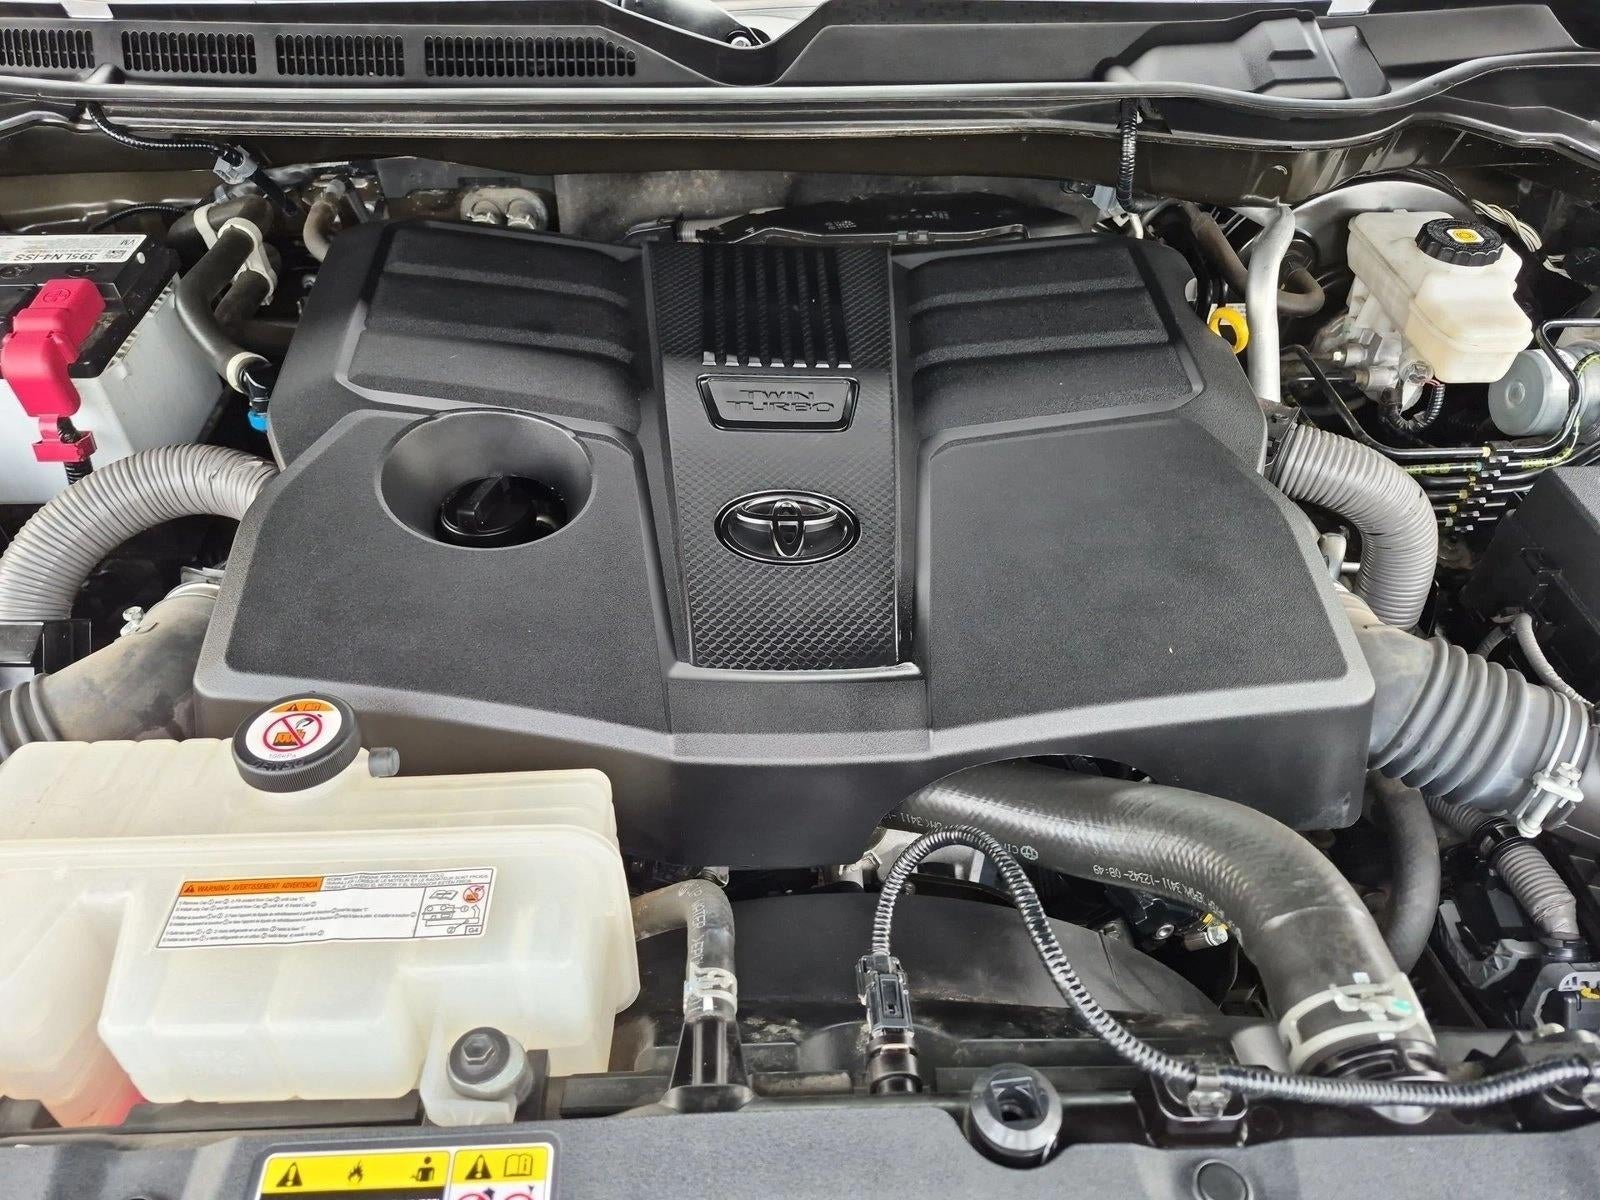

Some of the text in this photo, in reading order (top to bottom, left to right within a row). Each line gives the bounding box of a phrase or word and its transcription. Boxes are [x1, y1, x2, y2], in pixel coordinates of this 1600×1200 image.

[739, 389, 814, 400] TWIN
[726, 400, 835, 412] TURBO
[197, 881, 318, 892] WARNING AVERTISSEMENT ADVERTENCIA
